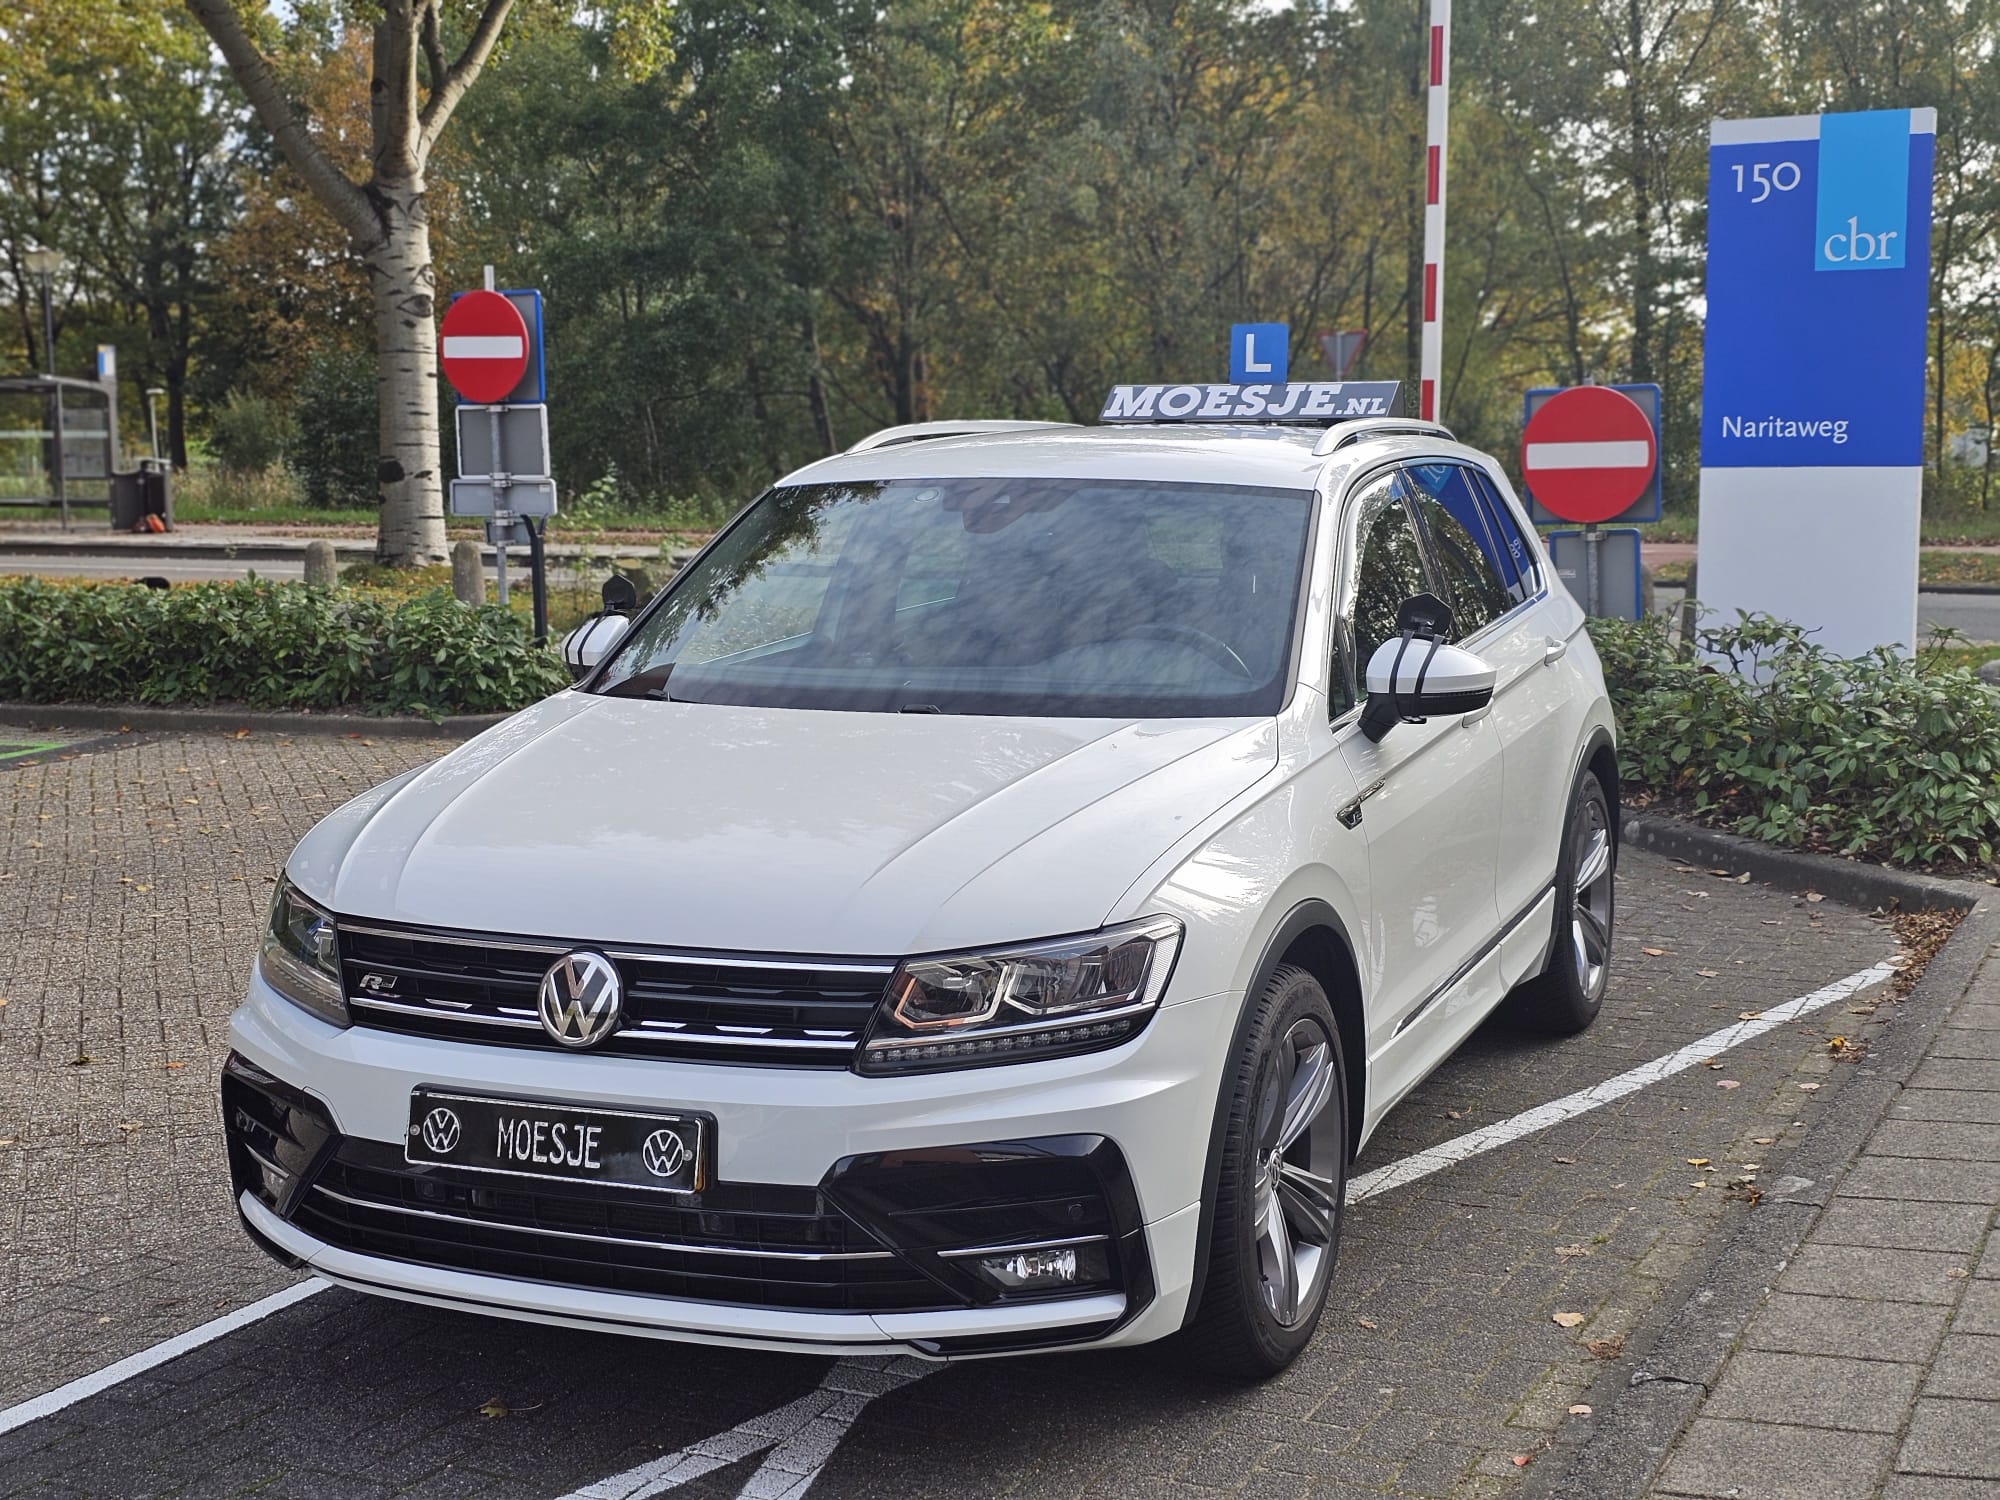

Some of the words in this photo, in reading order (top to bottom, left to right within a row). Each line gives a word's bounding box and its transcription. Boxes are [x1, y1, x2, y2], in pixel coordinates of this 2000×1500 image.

[1731, 161, 1801, 204] 150
[1824, 215, 1898, 262] cbr
[1245, 333, 1272, 373] L
[1103, 384, 1387, 417] MOESJE.NL
[1722, 415, 1849, 444] Naritaweg
[496, 1117, 602, 1169] MOESJE
